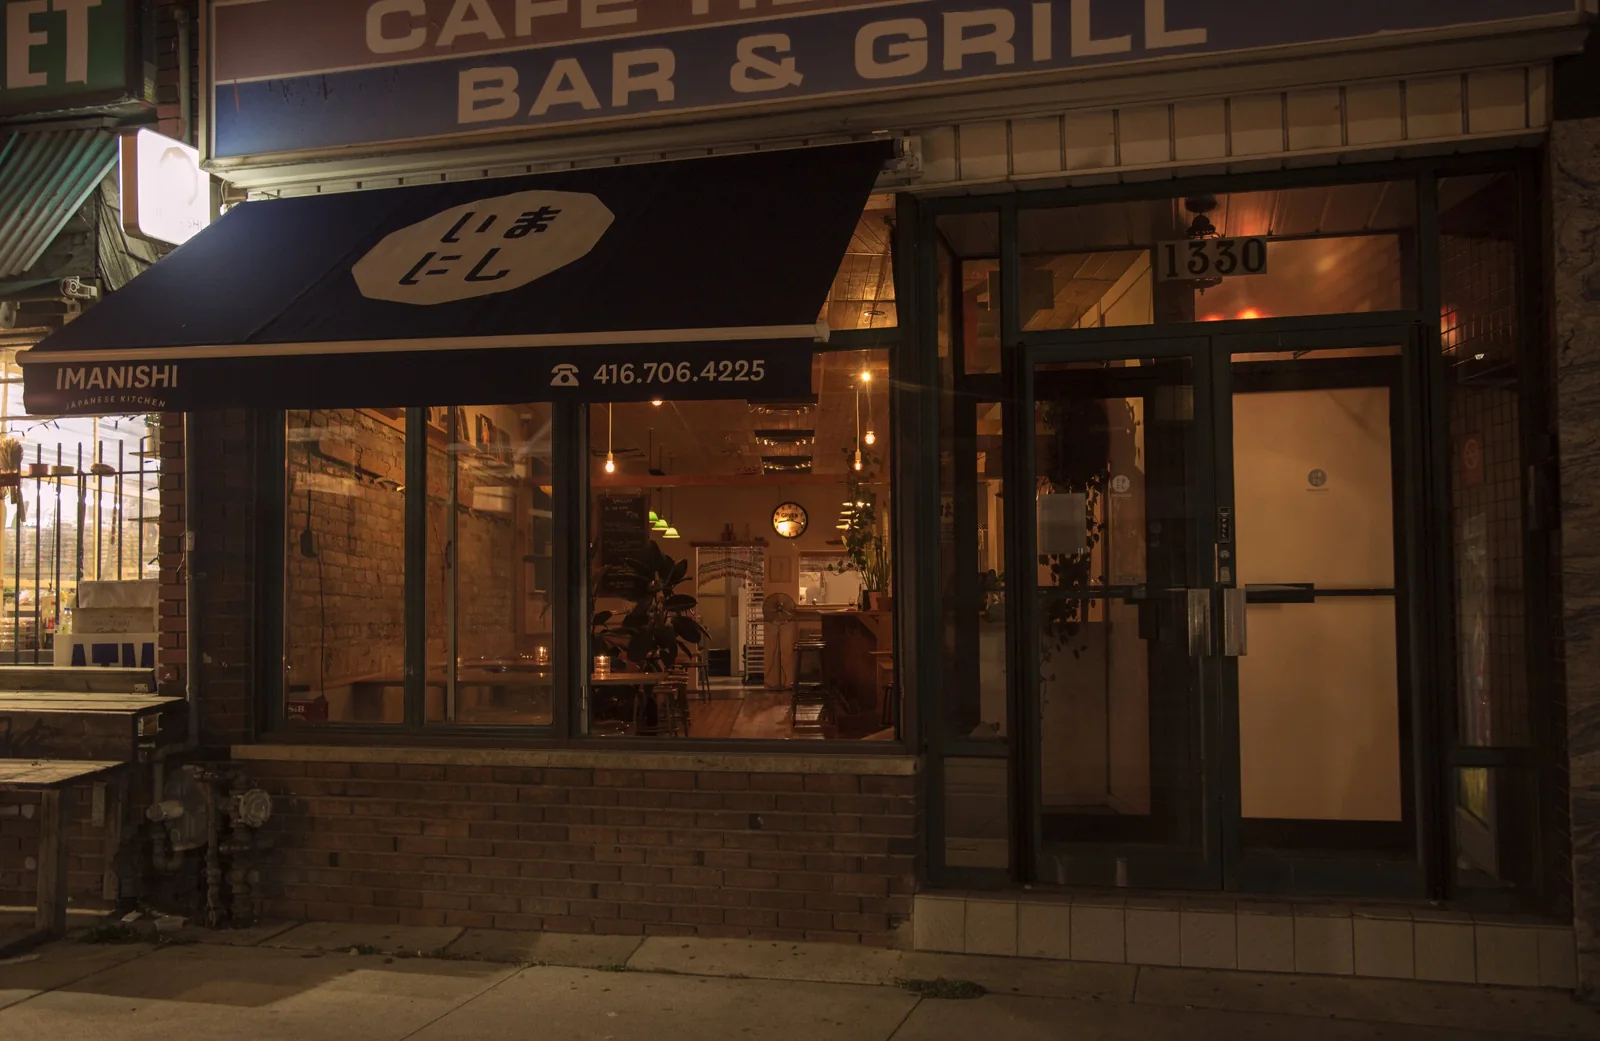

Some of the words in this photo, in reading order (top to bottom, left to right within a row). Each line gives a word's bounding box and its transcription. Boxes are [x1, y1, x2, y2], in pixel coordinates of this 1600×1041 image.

[0, 0, 102, 89] ET
[457, 48, 676, 124] BAR
[730, 33, 803, 93] &
[854, 0, 1208, 79] GRILL
[440, 205, 562, 243] いま
[398, 247, 511, 286] にし
[1164, 238, 1266, 278] 1330
[56, 364, 178, 391] IMANISHI
[593, 359, 766, 385] 416.706.4225
[65, 396, 116, 411] JAPANESE
[120, 395, 167, 408] KITCHEN
